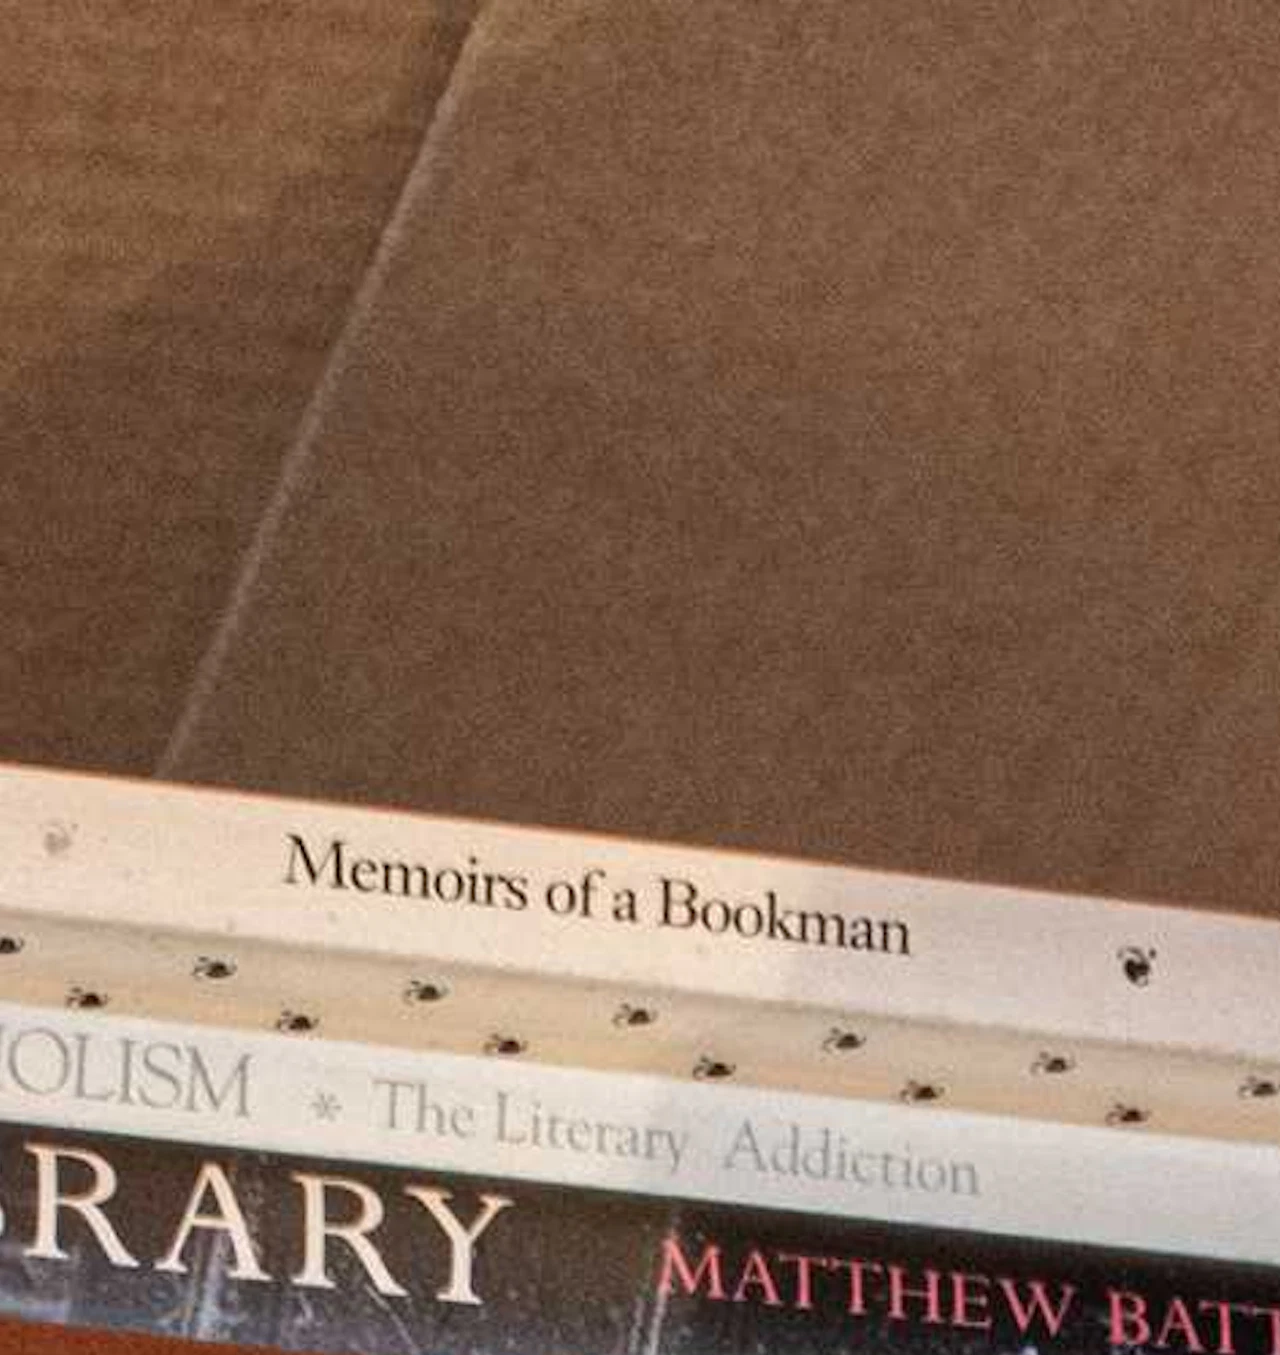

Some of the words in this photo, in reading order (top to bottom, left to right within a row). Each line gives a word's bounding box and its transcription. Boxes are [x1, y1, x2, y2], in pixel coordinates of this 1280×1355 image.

[282, 834, 529, 911] Memoirs
[545, 868, 607, 919] of
[613, 885, 639, 923] a
[658, 877, 912, 957] Bookman
[371, 1077, 475, 1141] The
[495, 1091, 690, 1175] Literary
[723, 1119, 982, 1199] Addiction
[658, 1234, 1078, 1338] MATTHEW
